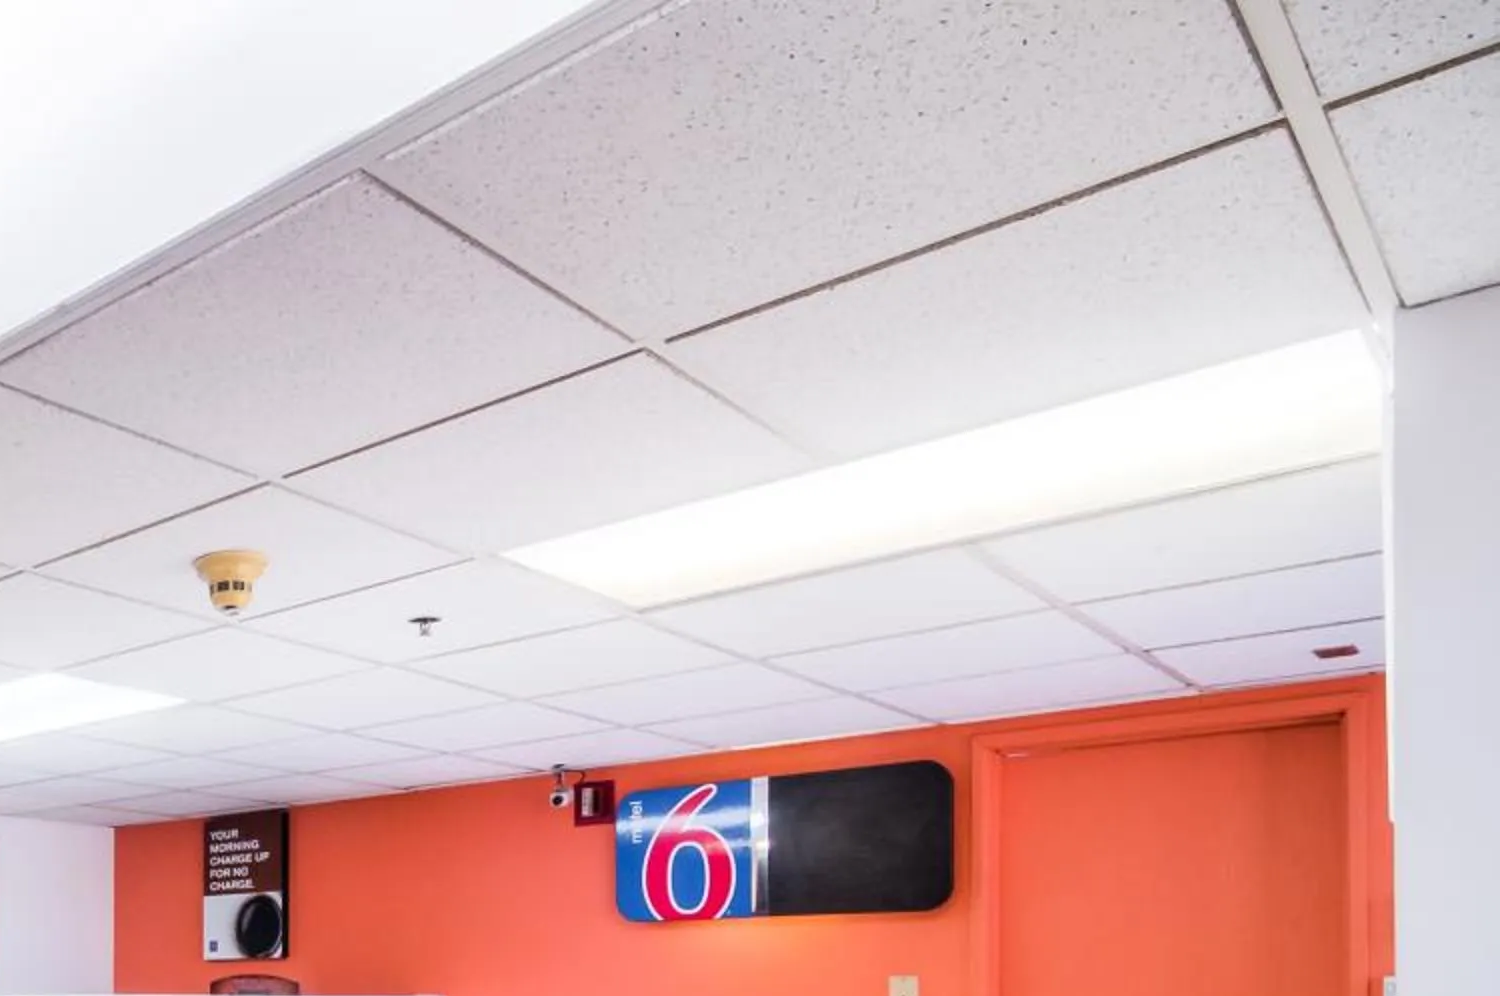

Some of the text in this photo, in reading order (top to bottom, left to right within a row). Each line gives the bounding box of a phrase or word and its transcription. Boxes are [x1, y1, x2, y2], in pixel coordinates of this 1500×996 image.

[210, 829, 239, 841] YOUR
[209, 840, 260, 853] MORNING
[642, 784, 736, 920] 6
[209, 851, 270, 866] CHARGE UP
[209, 866, 248, 879] FOR NO
